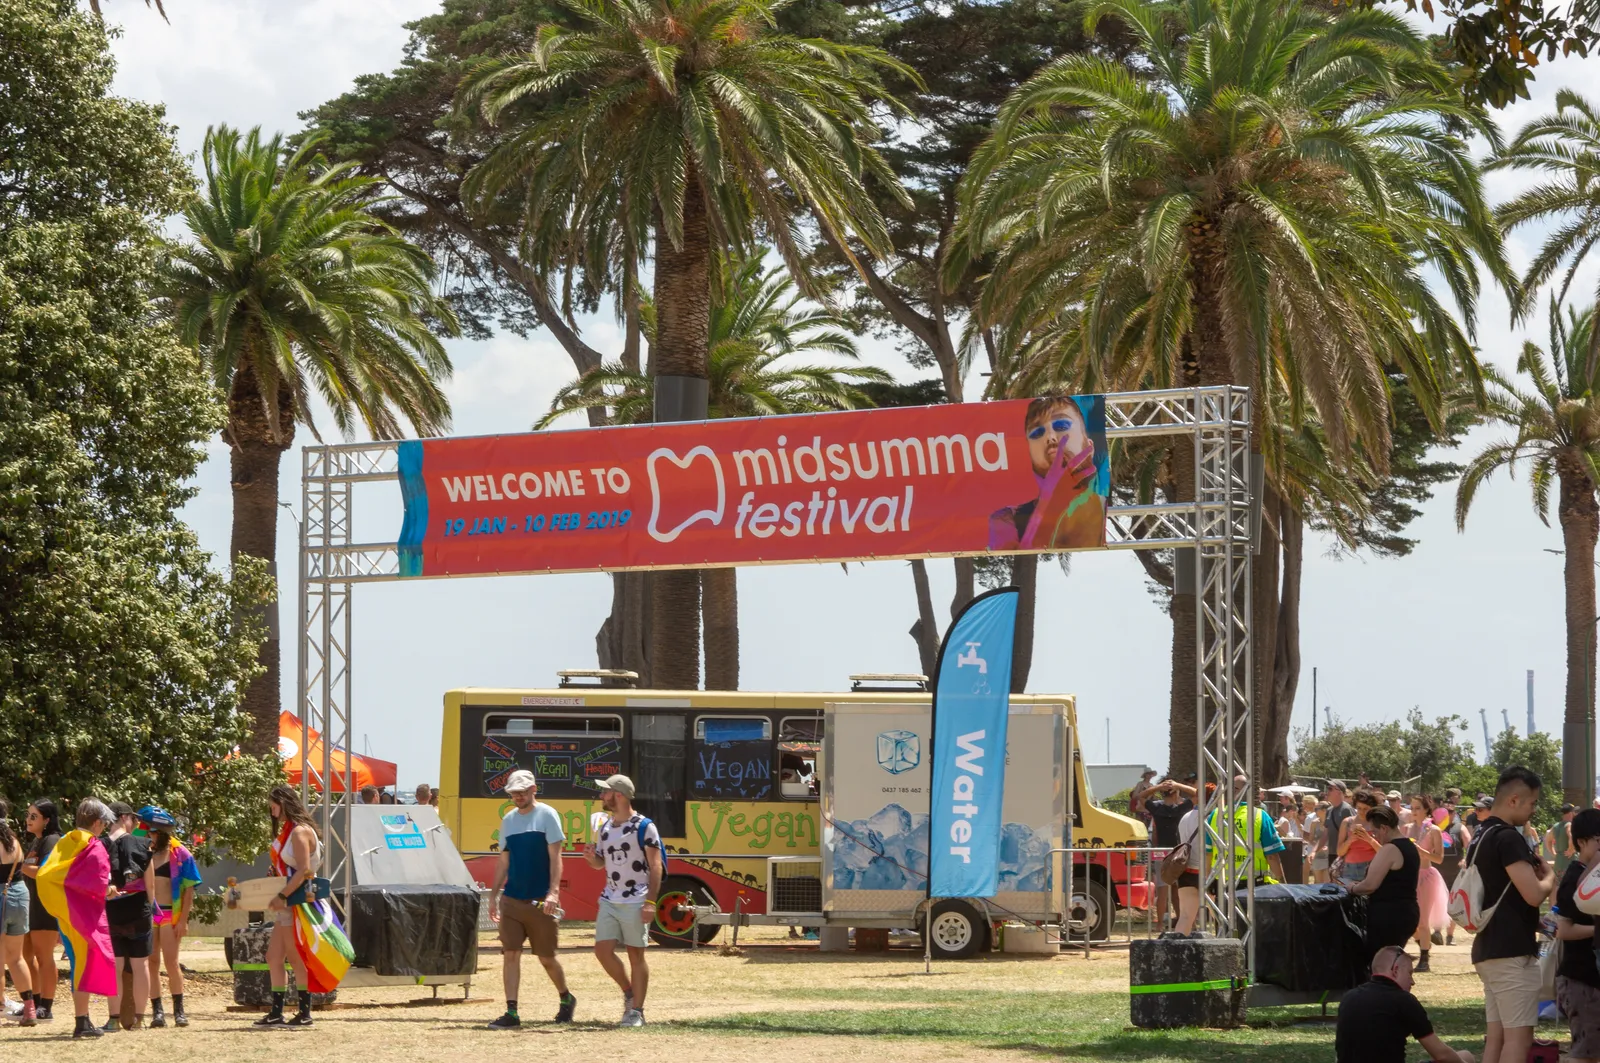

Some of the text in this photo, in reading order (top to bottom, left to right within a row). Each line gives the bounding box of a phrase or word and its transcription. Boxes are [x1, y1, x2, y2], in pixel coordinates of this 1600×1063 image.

[732, 431, 1009, 487] midsumma
[442, 467, 631, 503] WELCOME TO
[444, 517, 465, 536] 19
[468, 515, 506, 535] JAN
[524, 514, 545, 533] 10
[550, 512, 580, 531] FEB
[586, 509, 632, 530] 2019
[734, 485, 914, 539] festival
[523, 697, 557, 705] EMERGENCY
[950, 729, 986, 864] Water
[690, 802, 820, 853] Vegan
